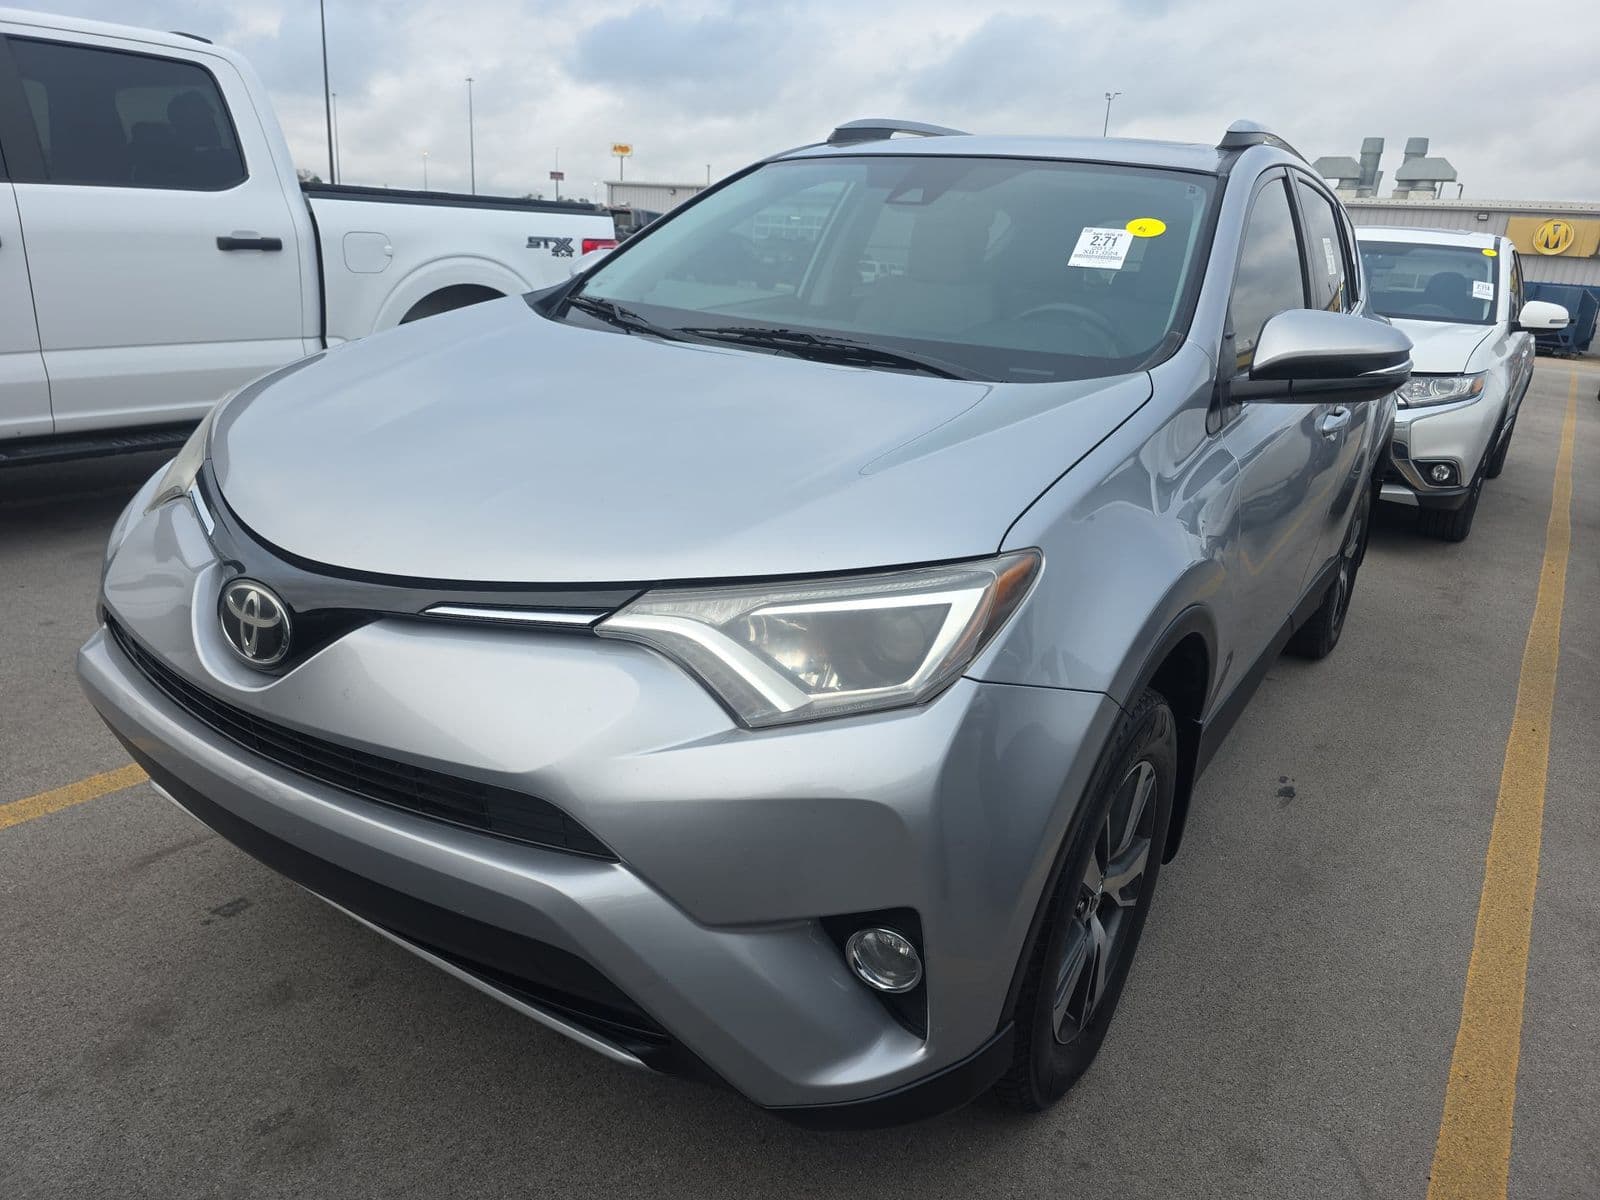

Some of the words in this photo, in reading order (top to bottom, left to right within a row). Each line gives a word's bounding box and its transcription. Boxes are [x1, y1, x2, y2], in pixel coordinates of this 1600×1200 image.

[526, 236, 574, 252] STX
[1090, 235, 1118, 247] 2:71
[1538, 221, 1568, 251] M
